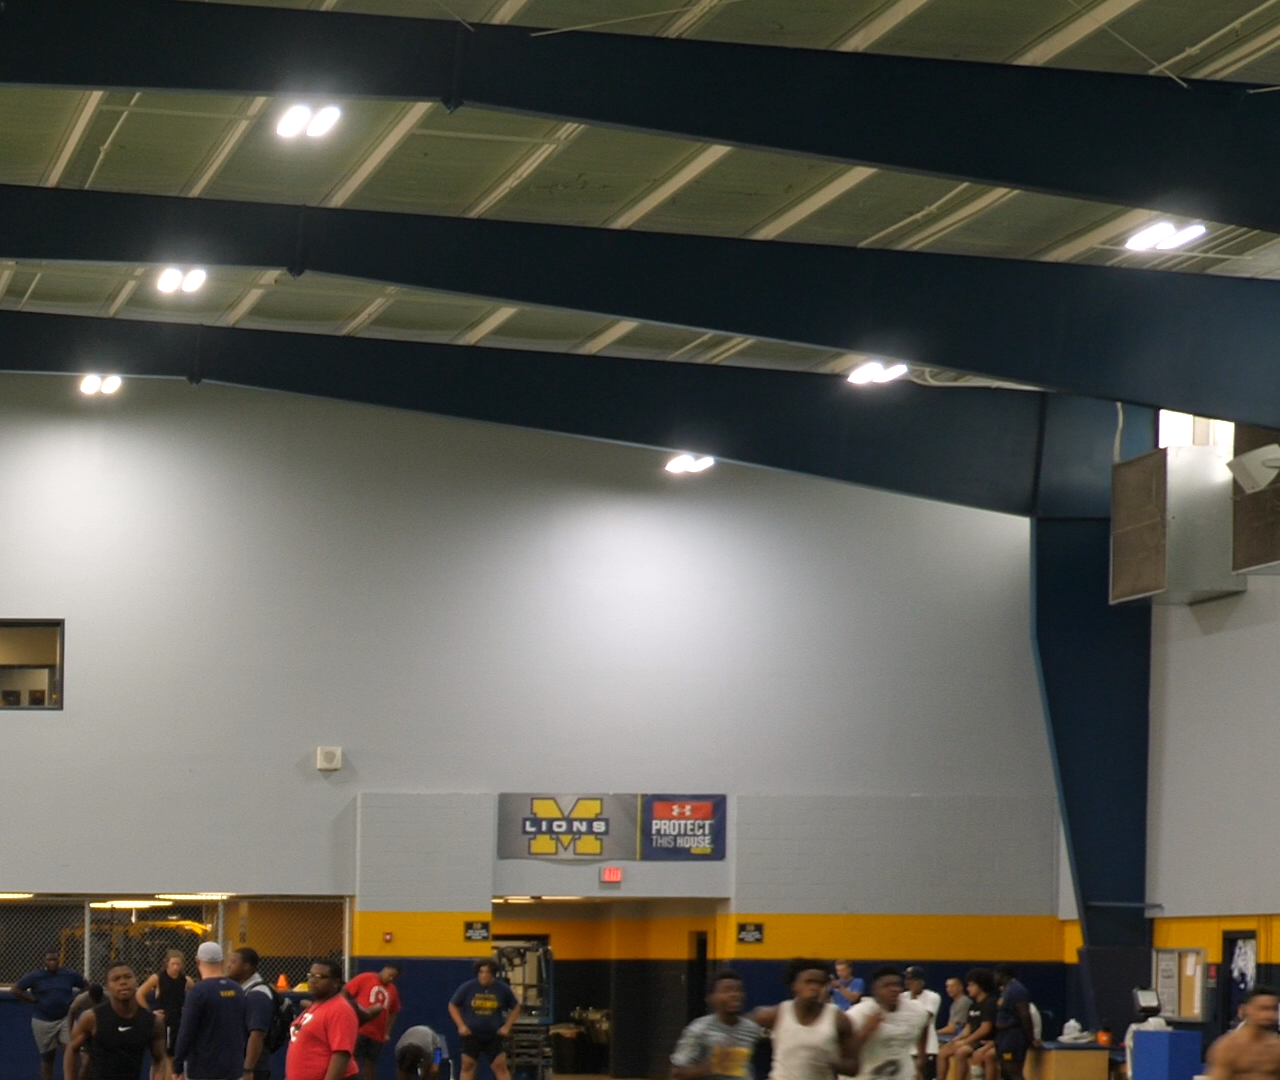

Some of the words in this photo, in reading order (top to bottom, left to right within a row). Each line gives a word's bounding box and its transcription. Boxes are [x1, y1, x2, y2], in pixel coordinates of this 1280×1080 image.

[525, 820, 606, 832] LIONS
[651, 820, 713, 835] PROTECT
[651, 835, 674, 848] THIS
